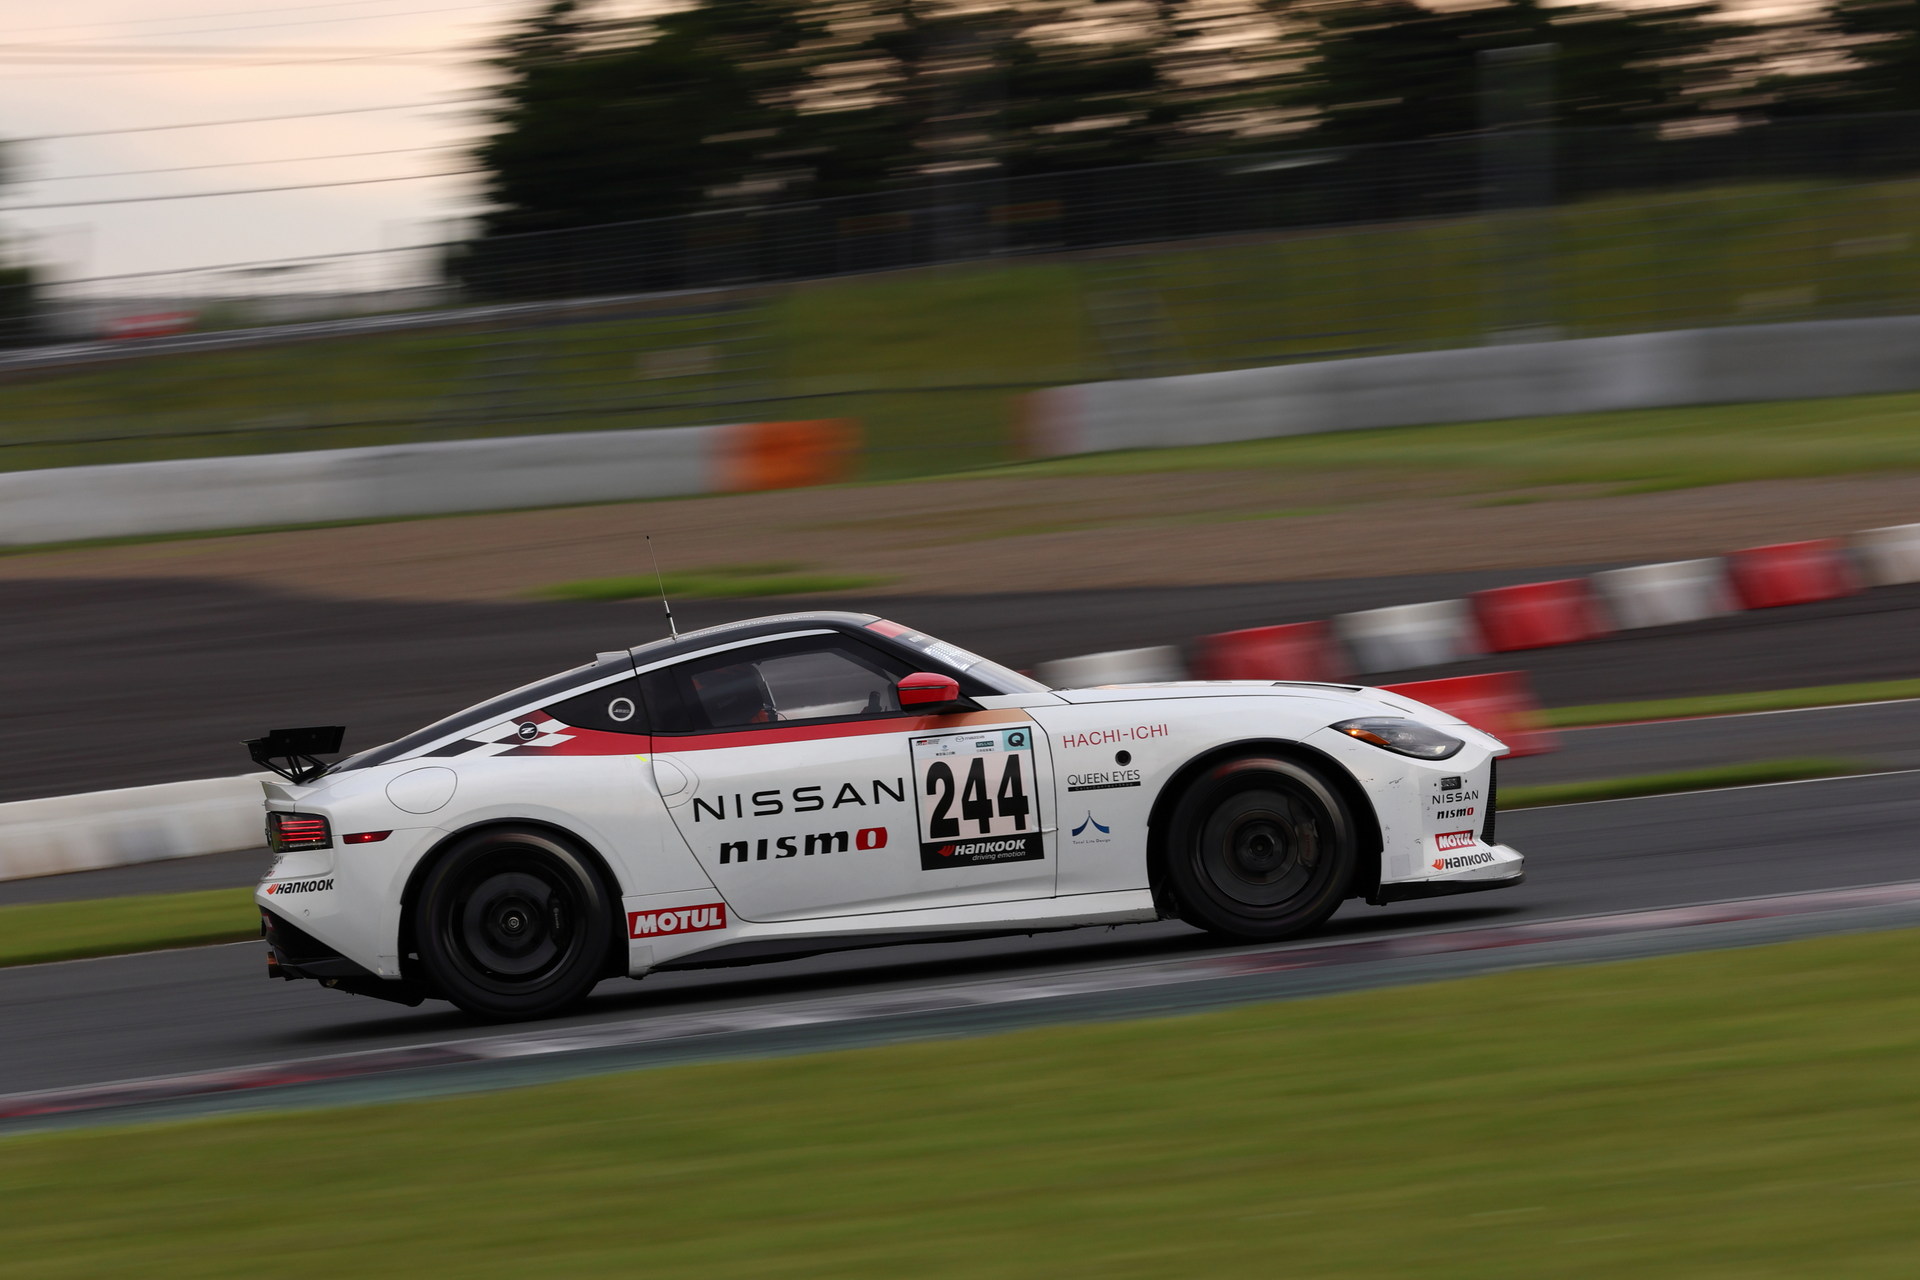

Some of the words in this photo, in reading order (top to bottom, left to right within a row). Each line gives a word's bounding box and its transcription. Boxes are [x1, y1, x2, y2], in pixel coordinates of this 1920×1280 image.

[1007, 732, 1025, 747] Q
[1062, 724, 1168, 748] HACHI-ICHI
[1067, 773, 1109, 785] QUEEN
[1112, 769, 1141, 782] EYES
[693, 777, 905, 822] NISSAN
[926, 754, 1030, 839] 244
[1432, 790, 1479, 805] NISSAN
[1437, 807, 1474, 819] nismo
[720, 827, 888, 864] nismo
[1438, 832, 1473, 849] MOTUL
[997, 851, 1026, 859] emotion
[633, 907, 722, 935] MOTUL
